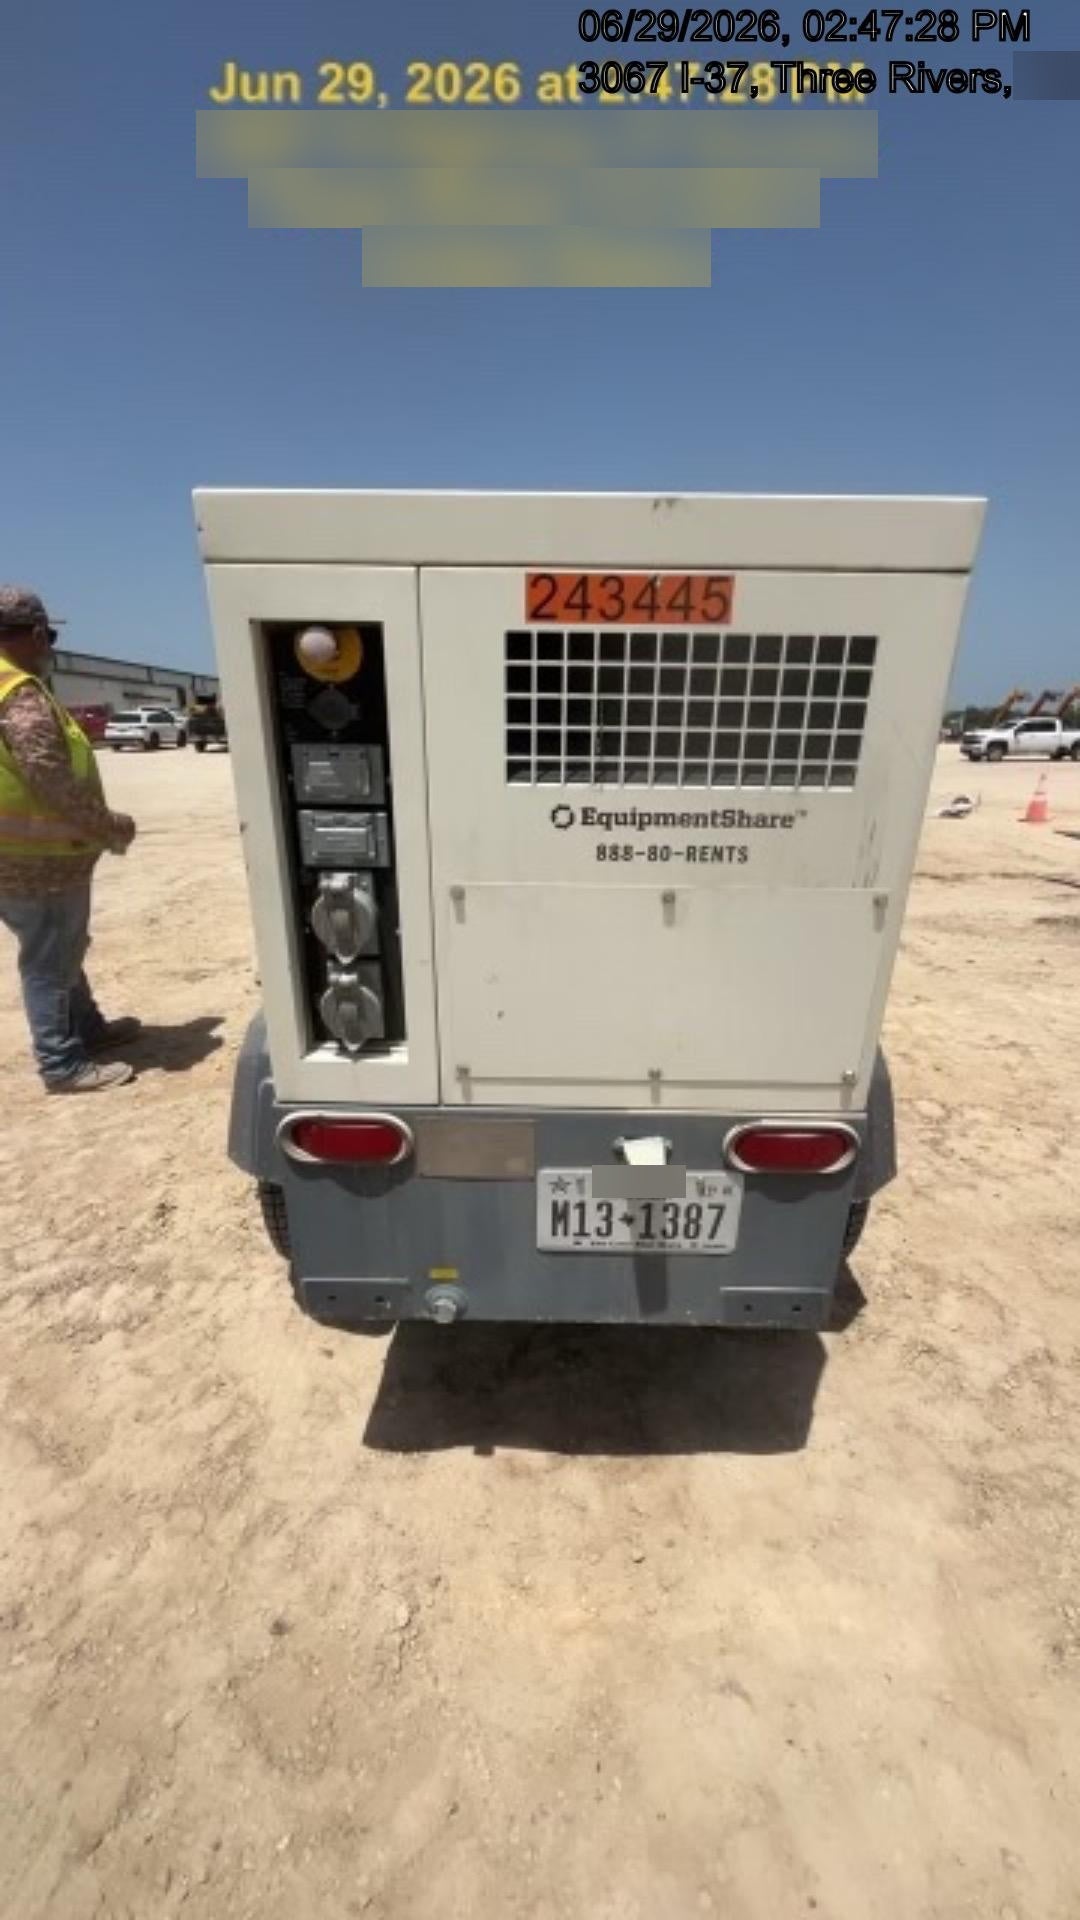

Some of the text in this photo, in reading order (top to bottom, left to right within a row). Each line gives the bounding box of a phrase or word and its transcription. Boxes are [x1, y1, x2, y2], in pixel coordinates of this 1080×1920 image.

[529, 573, 732, 622] 243445
[580, 805, 797, 831] EquipmentShare
[596, 844, 749, 864] 888-80-RENTS
